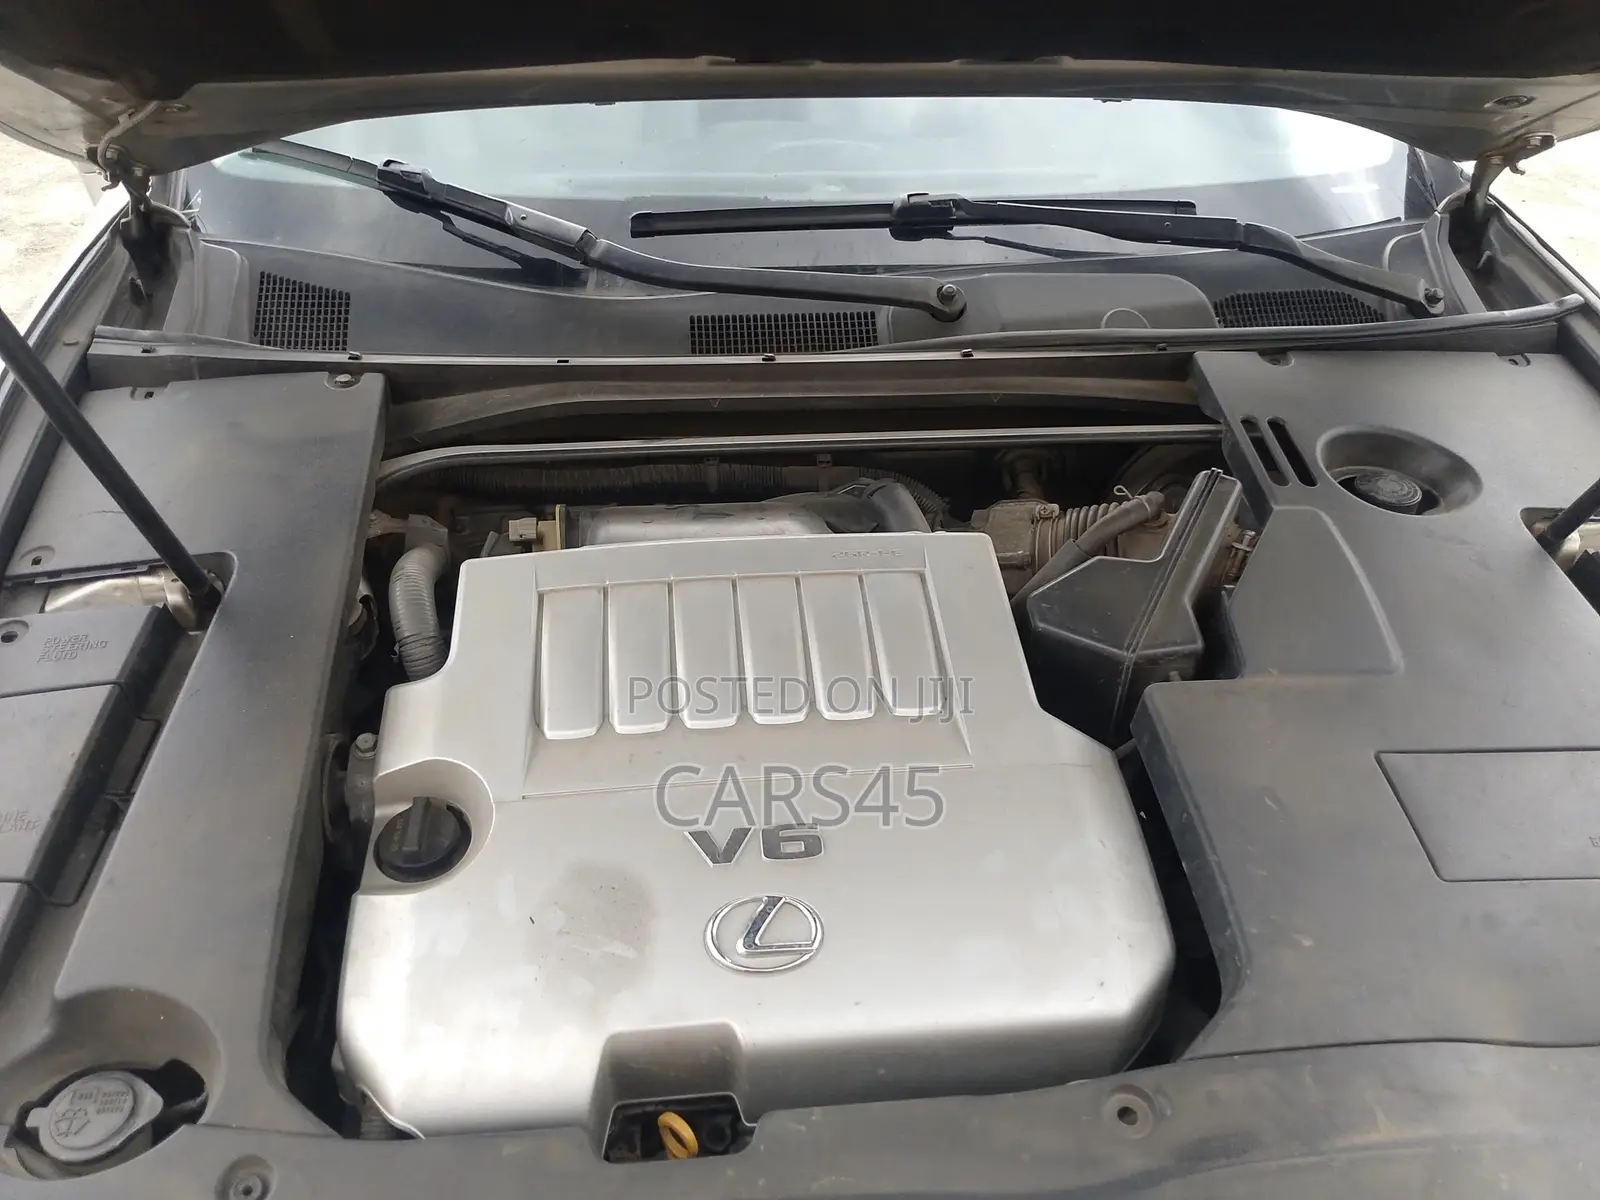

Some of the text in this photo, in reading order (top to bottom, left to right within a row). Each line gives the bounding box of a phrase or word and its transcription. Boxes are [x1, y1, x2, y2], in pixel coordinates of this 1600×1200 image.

[42, 640, 110, 652] STEERING
[43, 633, 89, 646] POWER
[36, 650, 78, 663] FLUID
[684, 822, 825, 867] V6
